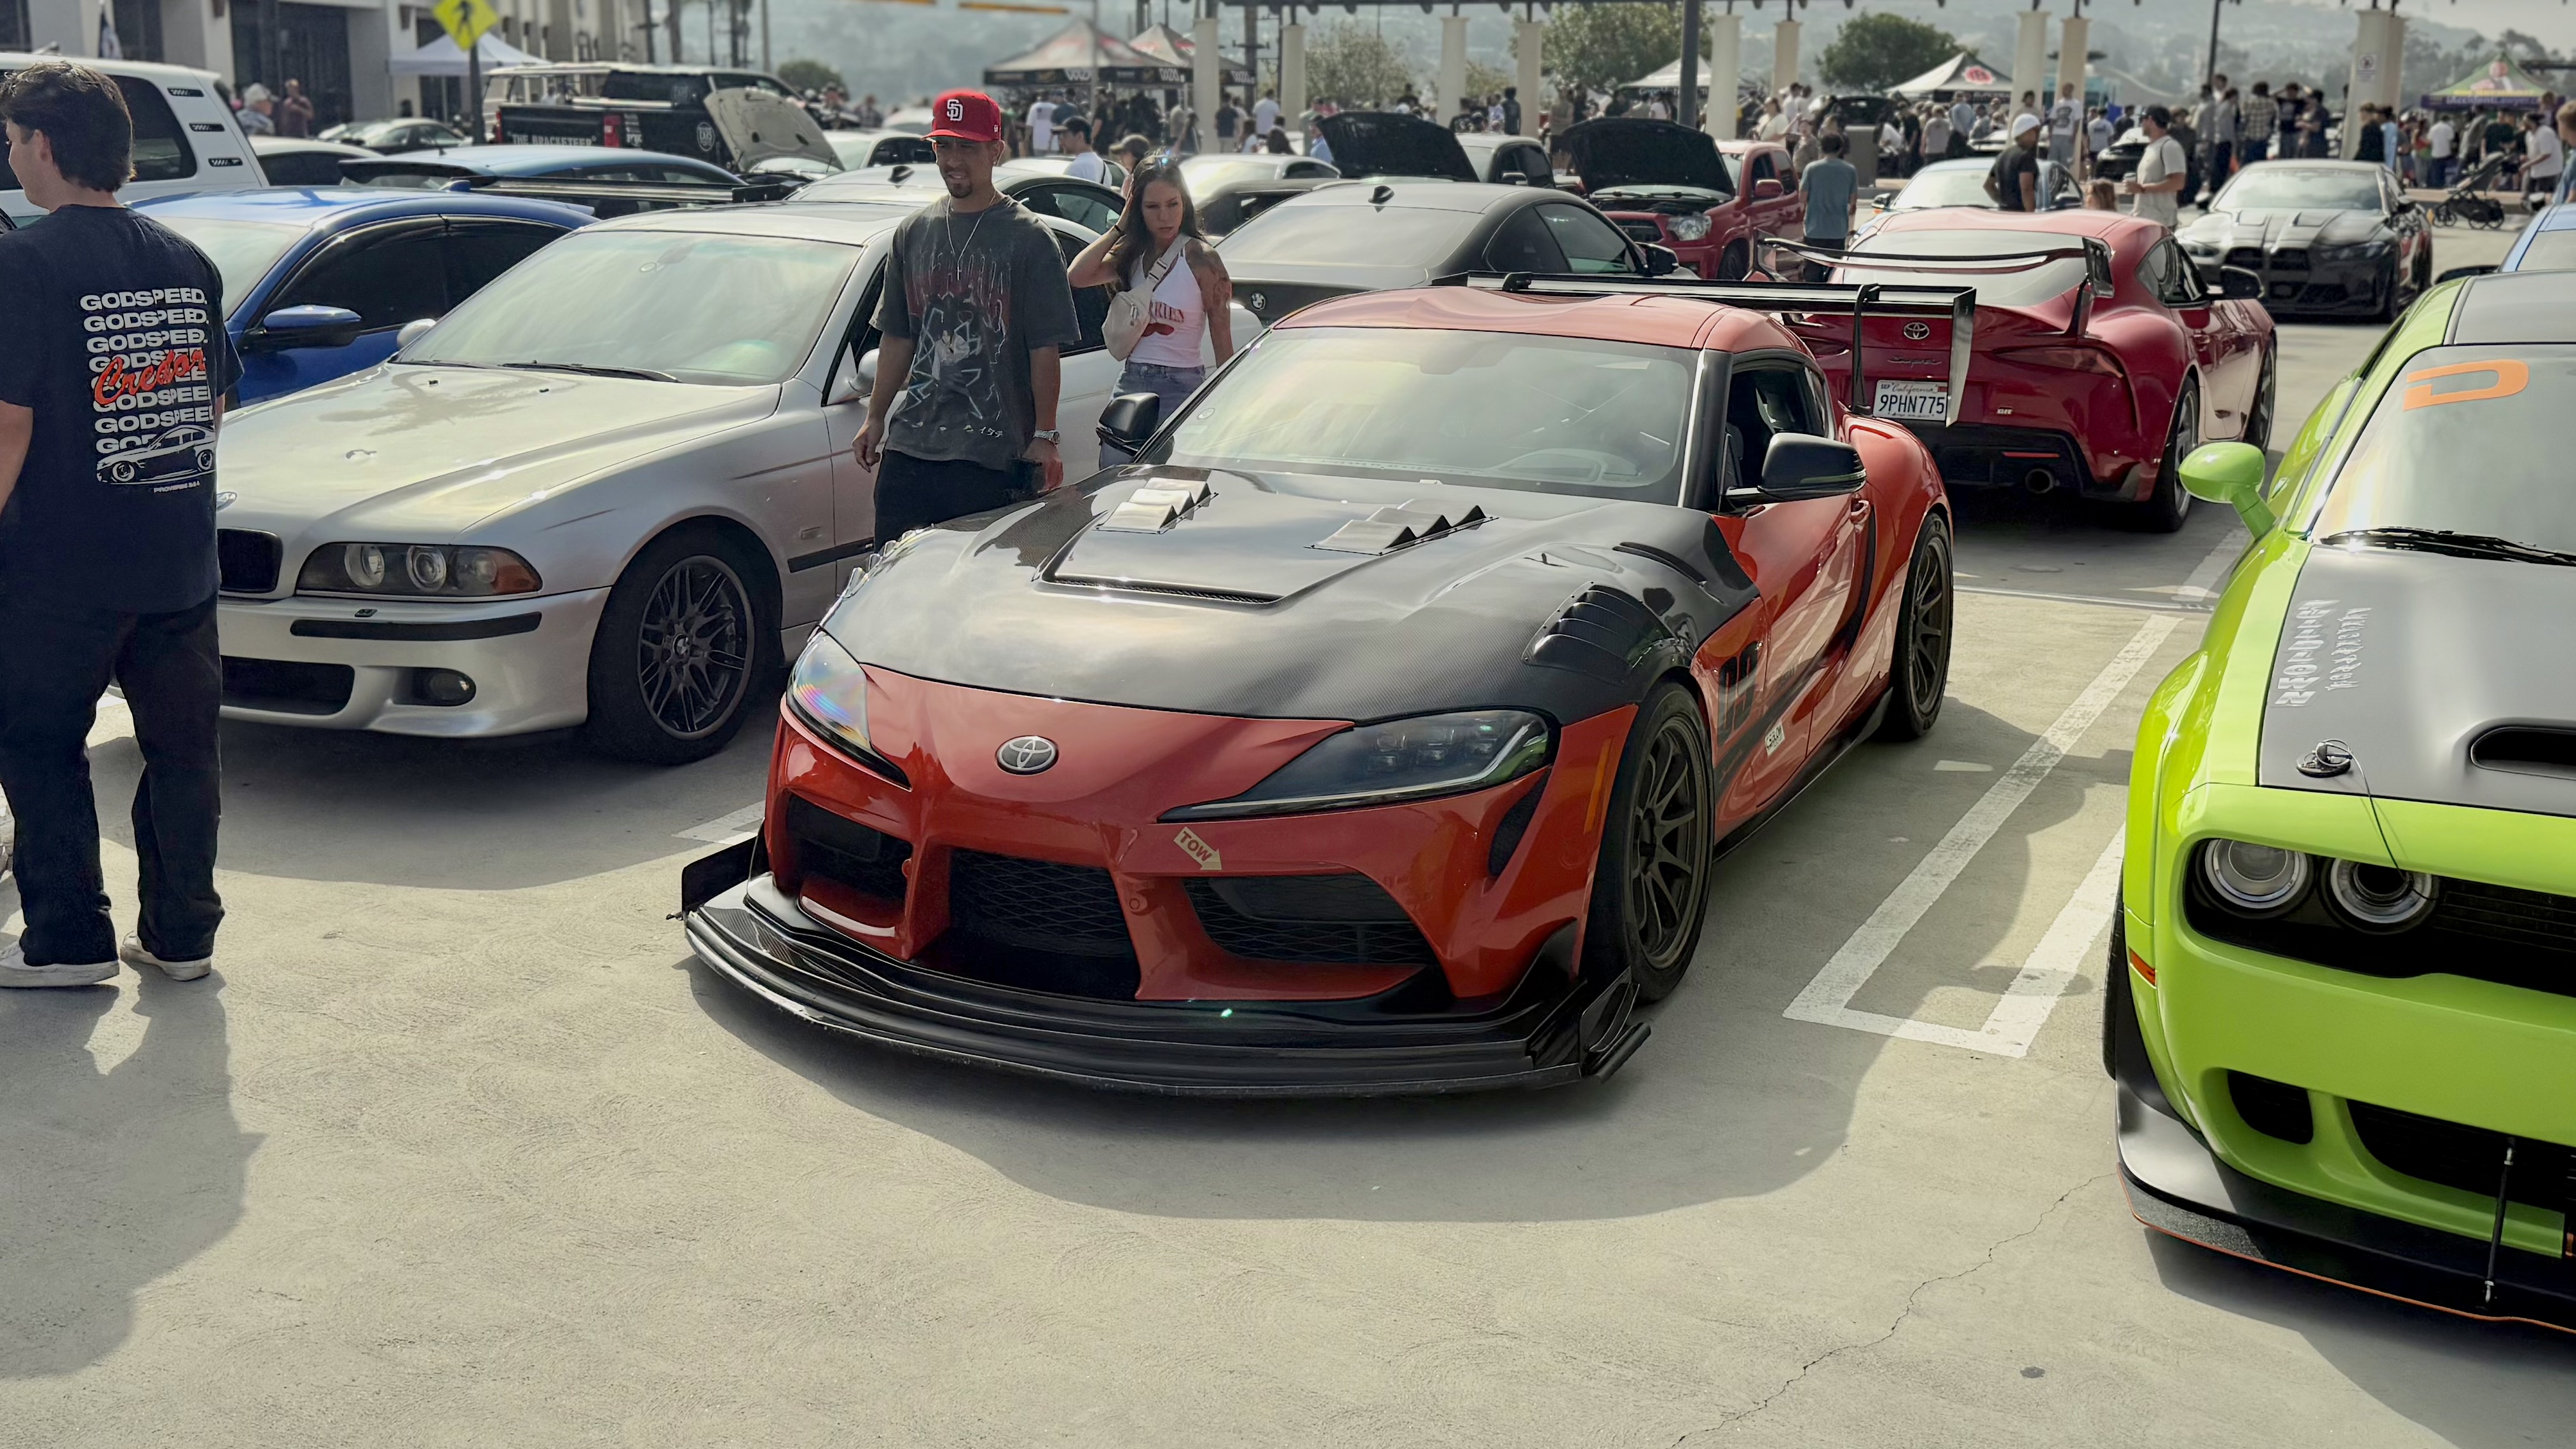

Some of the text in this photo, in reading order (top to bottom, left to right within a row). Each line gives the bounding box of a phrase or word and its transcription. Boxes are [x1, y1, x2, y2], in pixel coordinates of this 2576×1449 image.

[946, 99, 963, 121] SD
[80, 287, 207, 311] GODSPEED.
[93, 386, 212, 412] GODSPEE
[1891, 383, 1934, 394] California
[1879, 394, 1945, 414] 9PHN775
[1180, 831, 1213, 862] TOW
